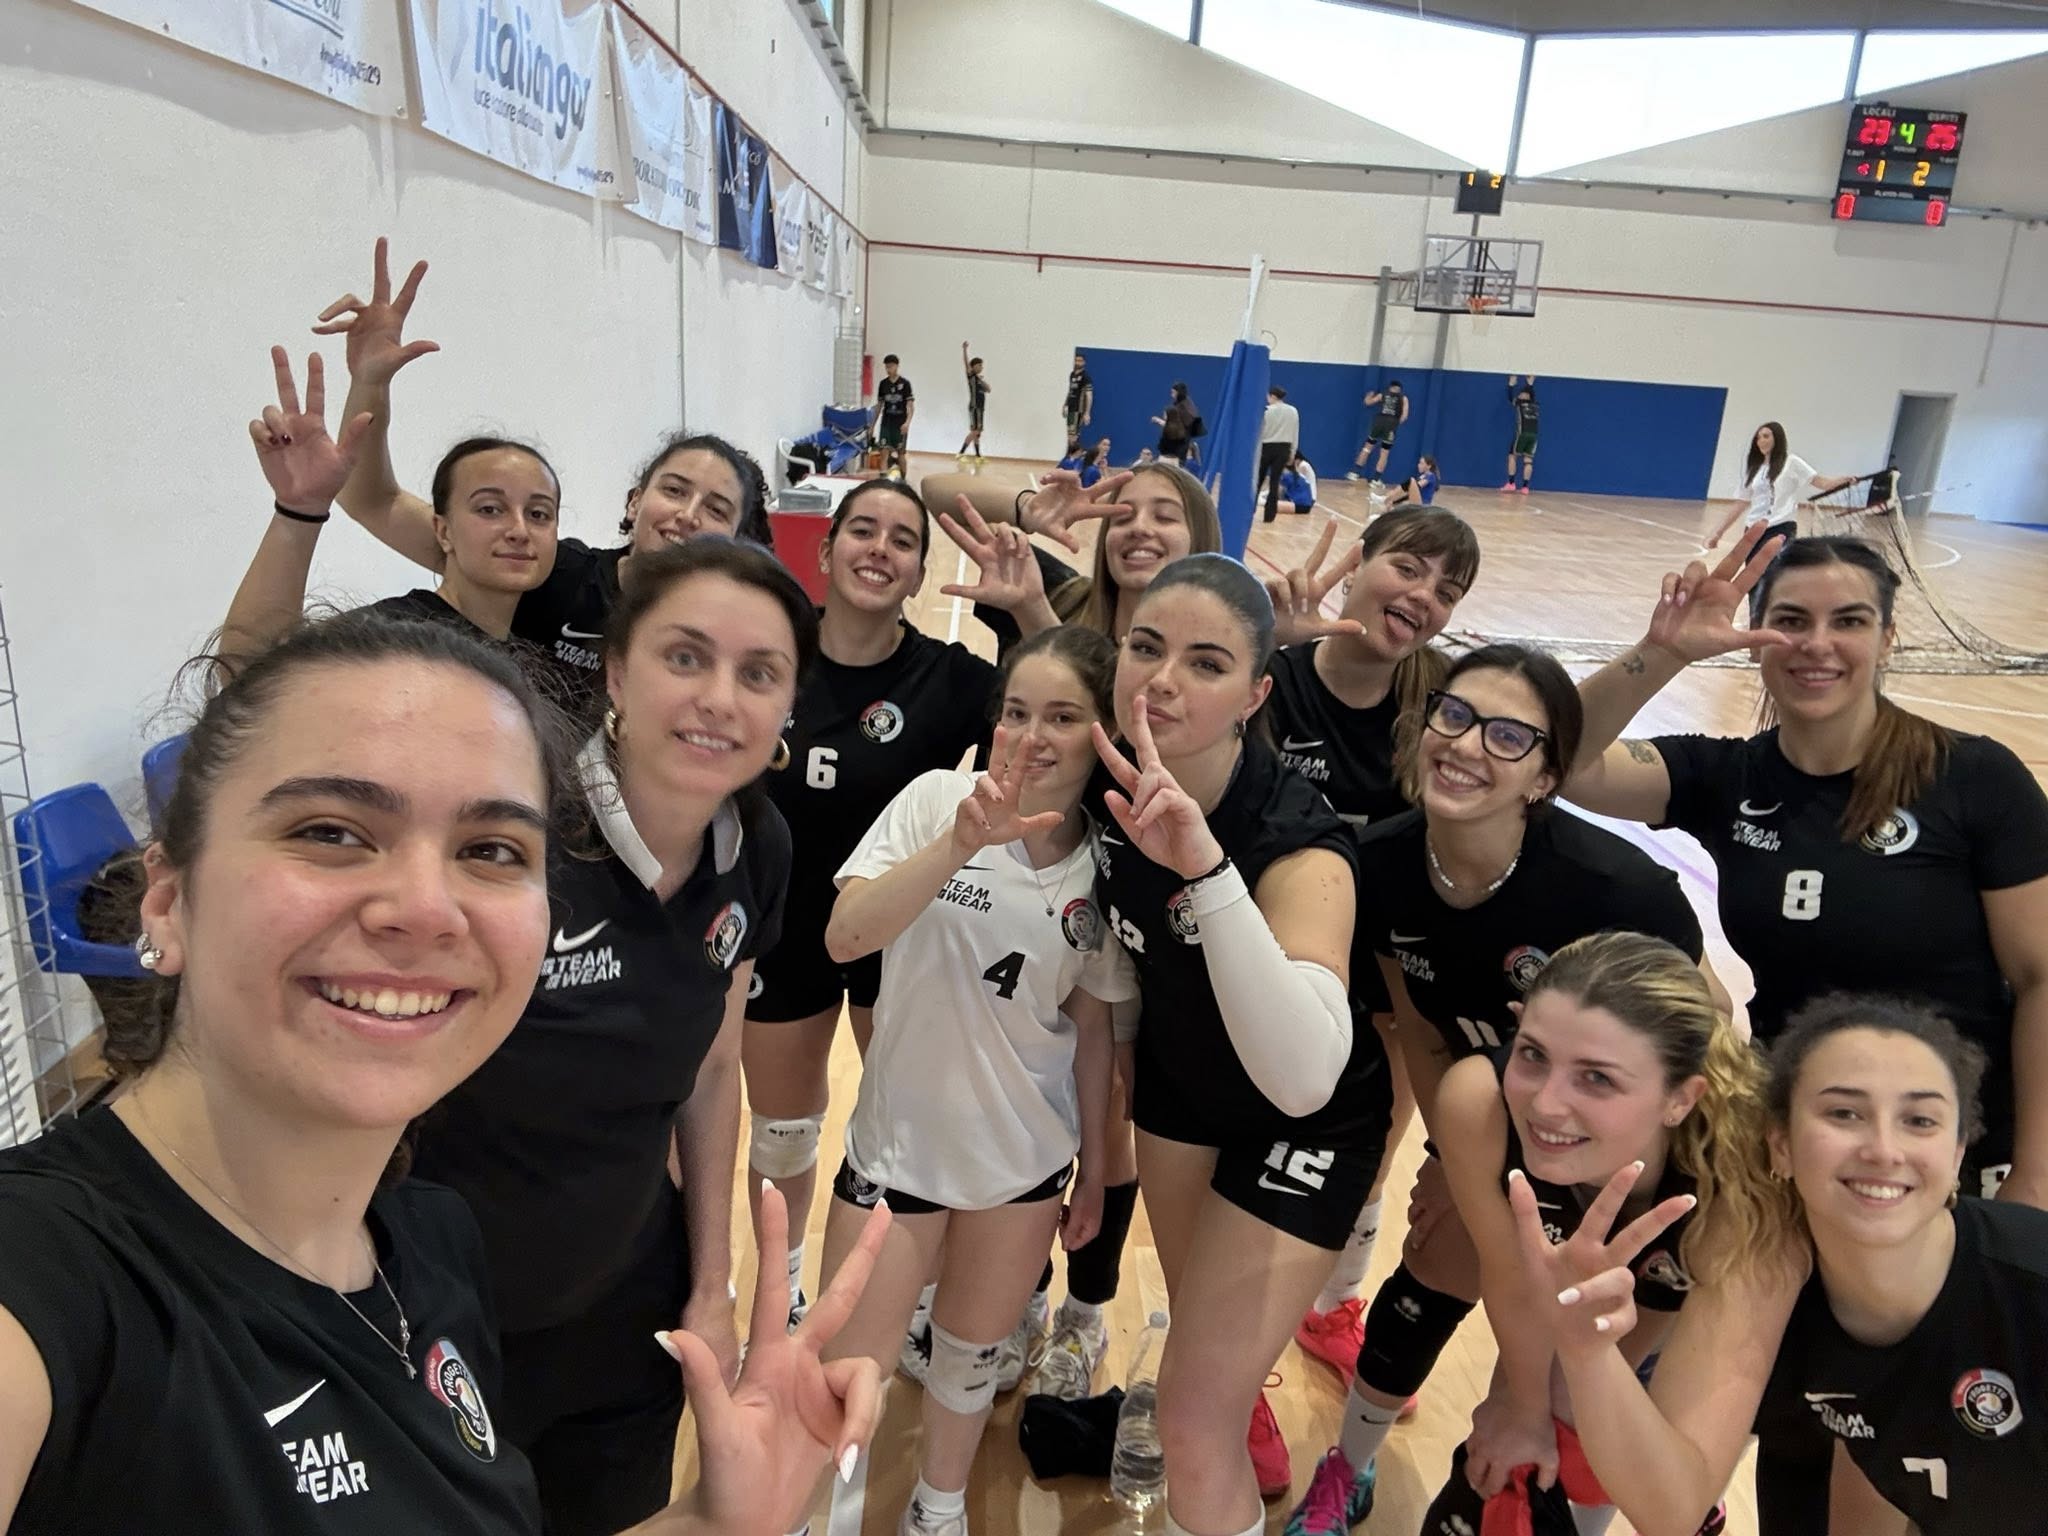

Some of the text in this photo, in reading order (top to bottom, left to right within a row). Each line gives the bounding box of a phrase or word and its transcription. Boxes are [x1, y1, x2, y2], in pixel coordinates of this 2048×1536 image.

[1900, 122, 1916, 144] 4
[1875, 159, 1886, 183] 1
[1912, 161, 1931, 187] 2
[562, 642, 599, 662] TEAM
[563, 653, 602, 671] WEAR
[806, 746, 838, 790] 6
[1286, 752, 1326, 771] TEAM
[1300, 767, 1331, 781] EAR
[1740, 821, 1778, 842] TEAM
[1741, 832, 1782, 851] WEAR
[945, 889, 993, 914] WEAR
[946, 878, 990, 901] TEAM
[1782, 870, 1824, 921] 8
[557, 945, 613, 974] TEAM
[1392, 949, 1430, 970] TEAM
[562, 959, 622, 988] WEAR
[982, 950, 1026, 1000] 4
[1264, 1141, 1336, 1191] 12
[281, 1431, 350, 1473] EAM
[1902, 1457, 1948, 1500] 7
